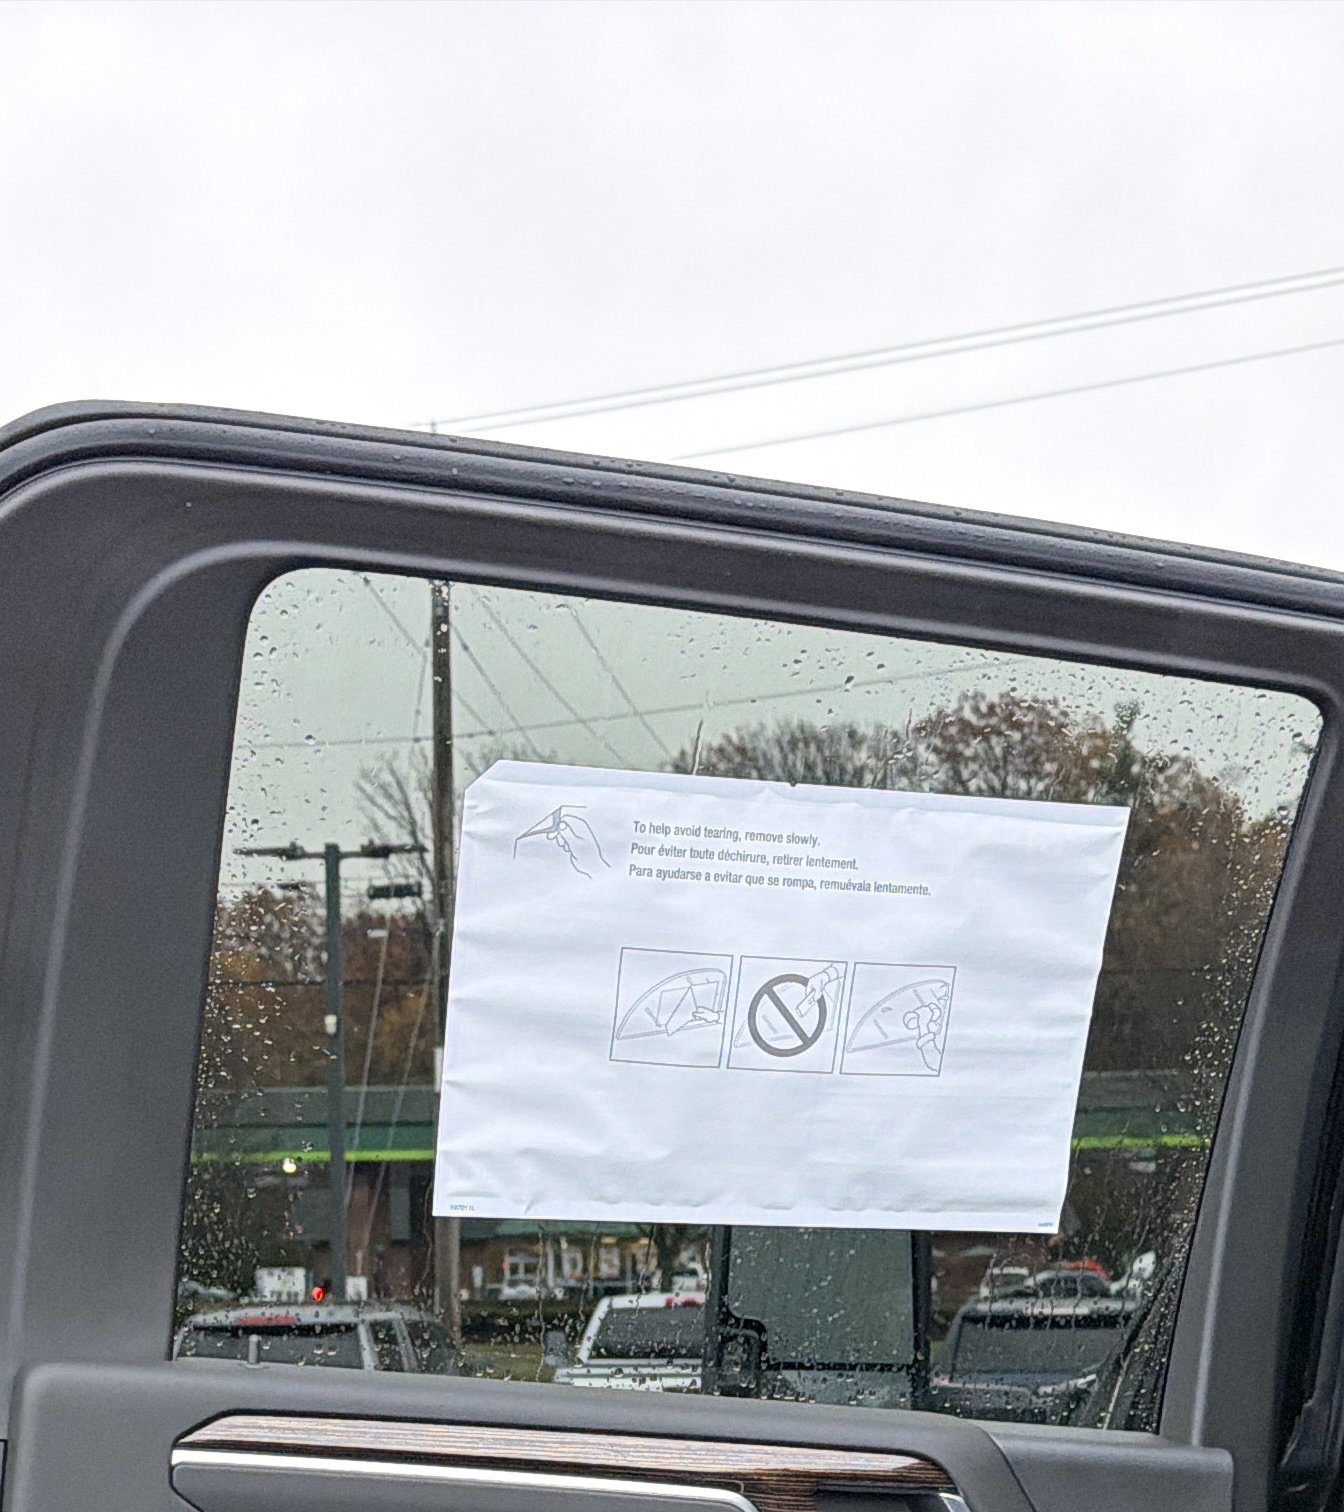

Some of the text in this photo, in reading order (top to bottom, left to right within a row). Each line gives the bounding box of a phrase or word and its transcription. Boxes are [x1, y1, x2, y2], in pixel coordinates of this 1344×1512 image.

[633, 821, 821, 848] To help avoid tearing, remove slowly.
[630, 842, 859, 870] Pour éviter toute déchirure, retirer lentement.
[628, 863, 932, 897] Para ayudarse a evitar que se rompa, remuévala lentamente.
